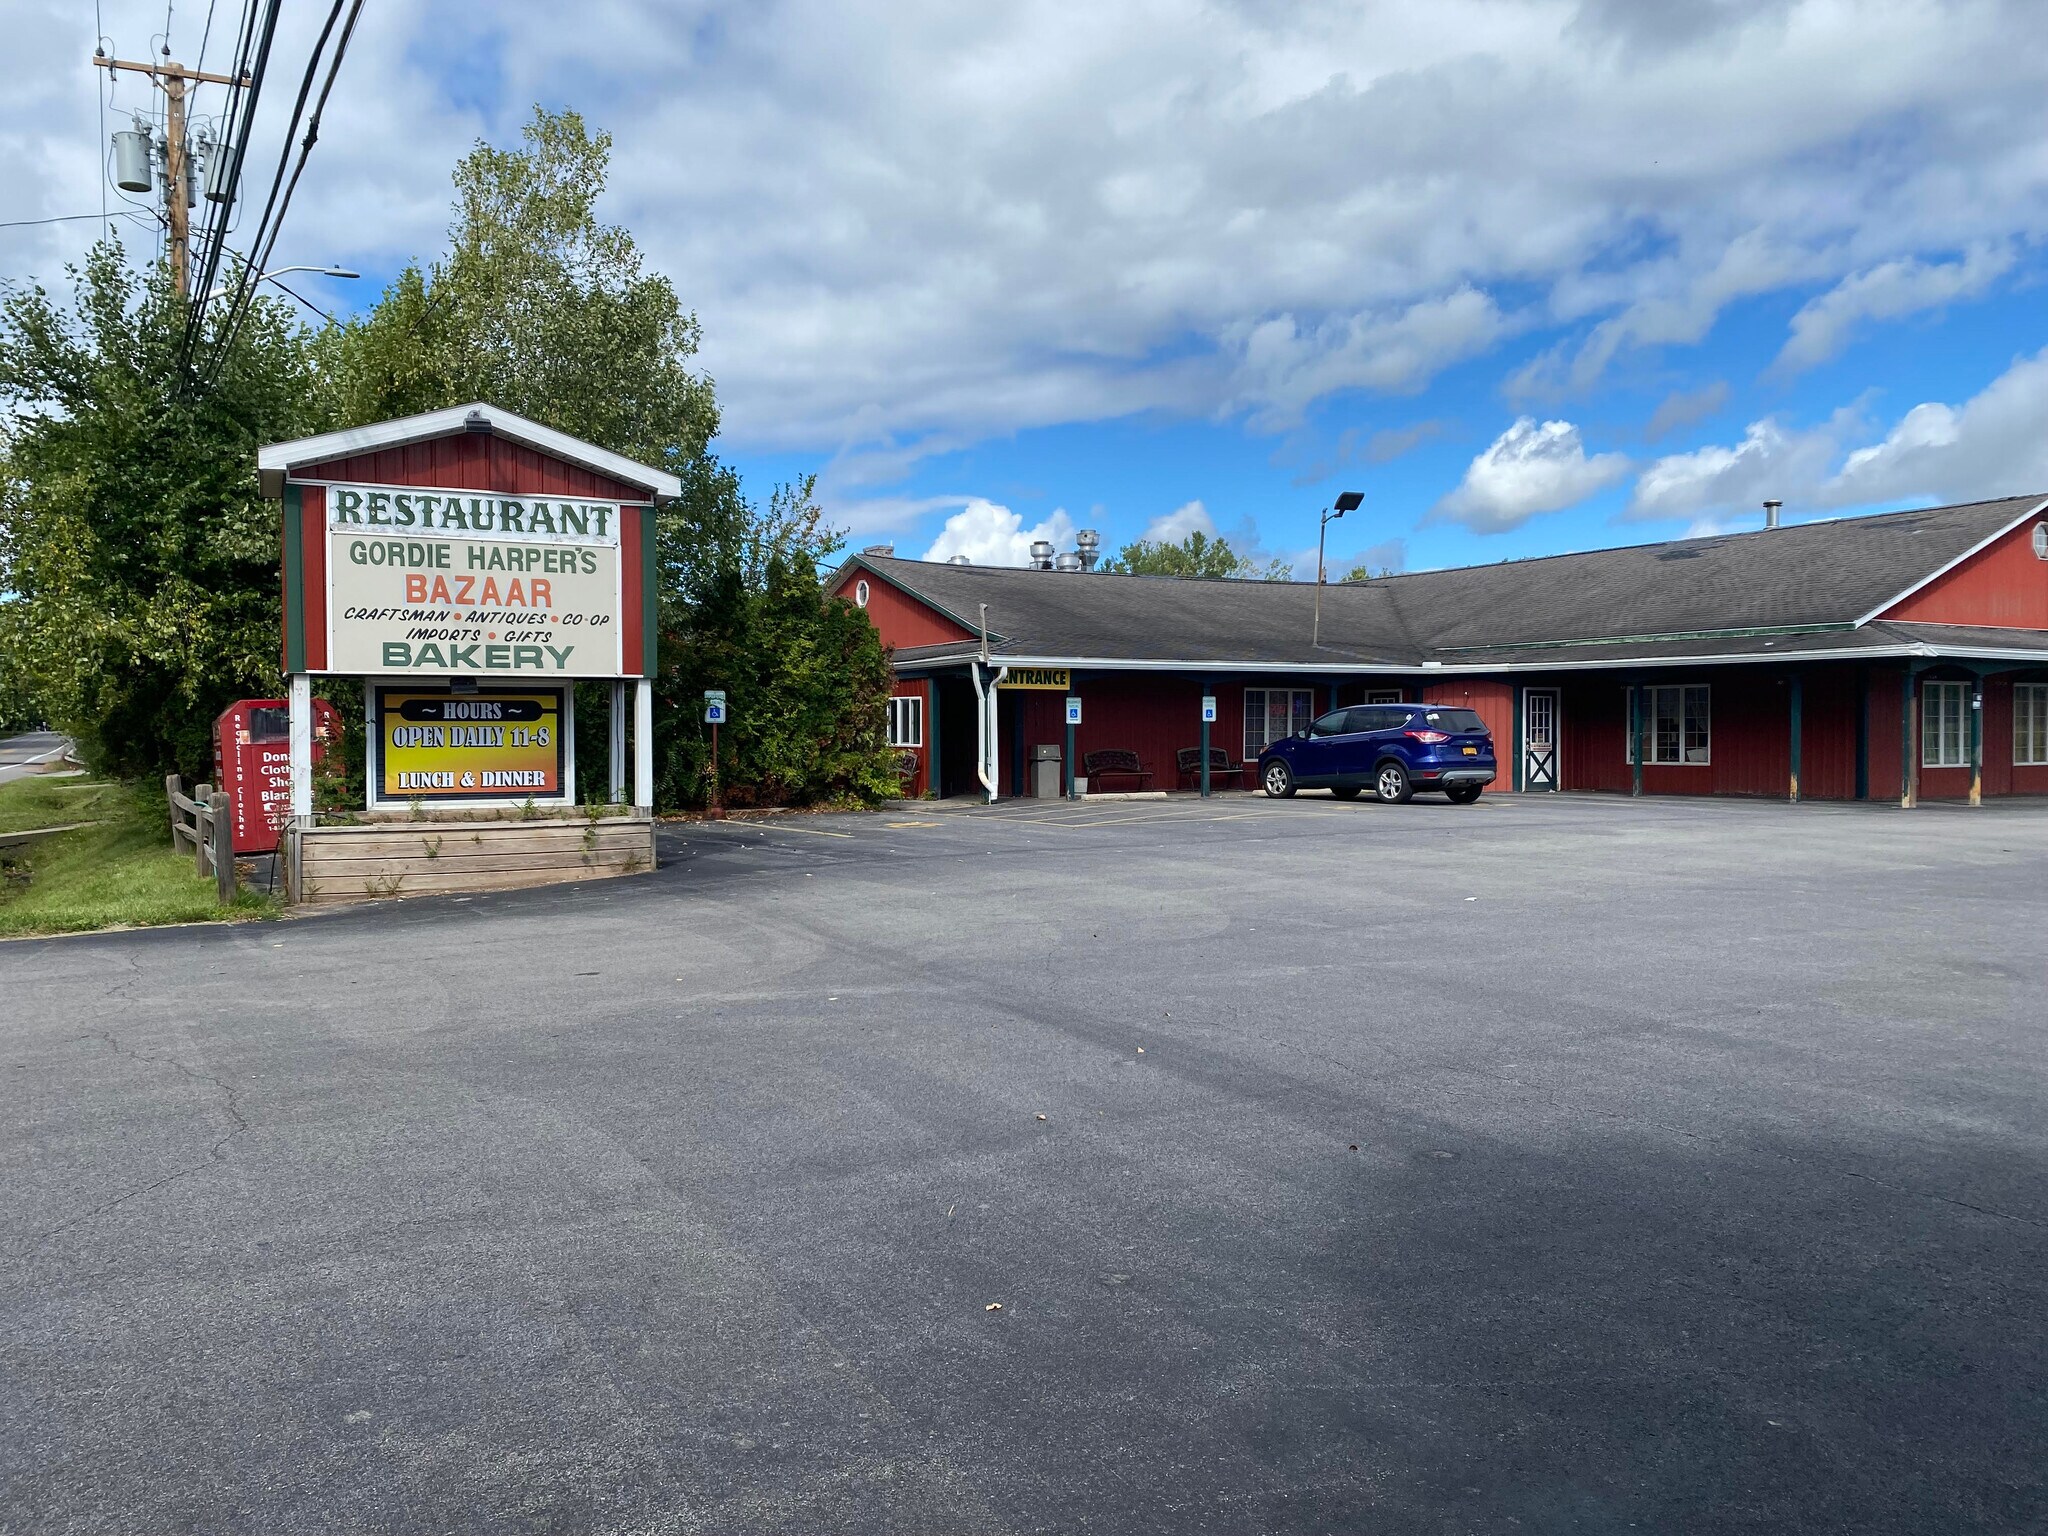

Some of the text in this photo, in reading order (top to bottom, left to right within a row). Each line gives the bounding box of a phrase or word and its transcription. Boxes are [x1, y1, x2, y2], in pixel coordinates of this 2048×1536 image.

[335, 490, 613, 536] RESTAURANT
[350, 540, 597, 574] GORDIE HARPER'S
[405, 573, 552, 608] BAZAAR
[344, 607, 450, 623] CRAFTSMAN
[465, 610, 546, 625] ANTIQUES
[405, 627, 553, 643] IMPORTS GIFTS
[382, 642, 575, 670] BAKERY
[443, 702, 502, 719] HOURS
[234, 715, 243, 781] Recycling
[392, 726, 550, 748] OPEN DAILY 11-8
[398, 770, 545, 789] LUNCH & DINNER
